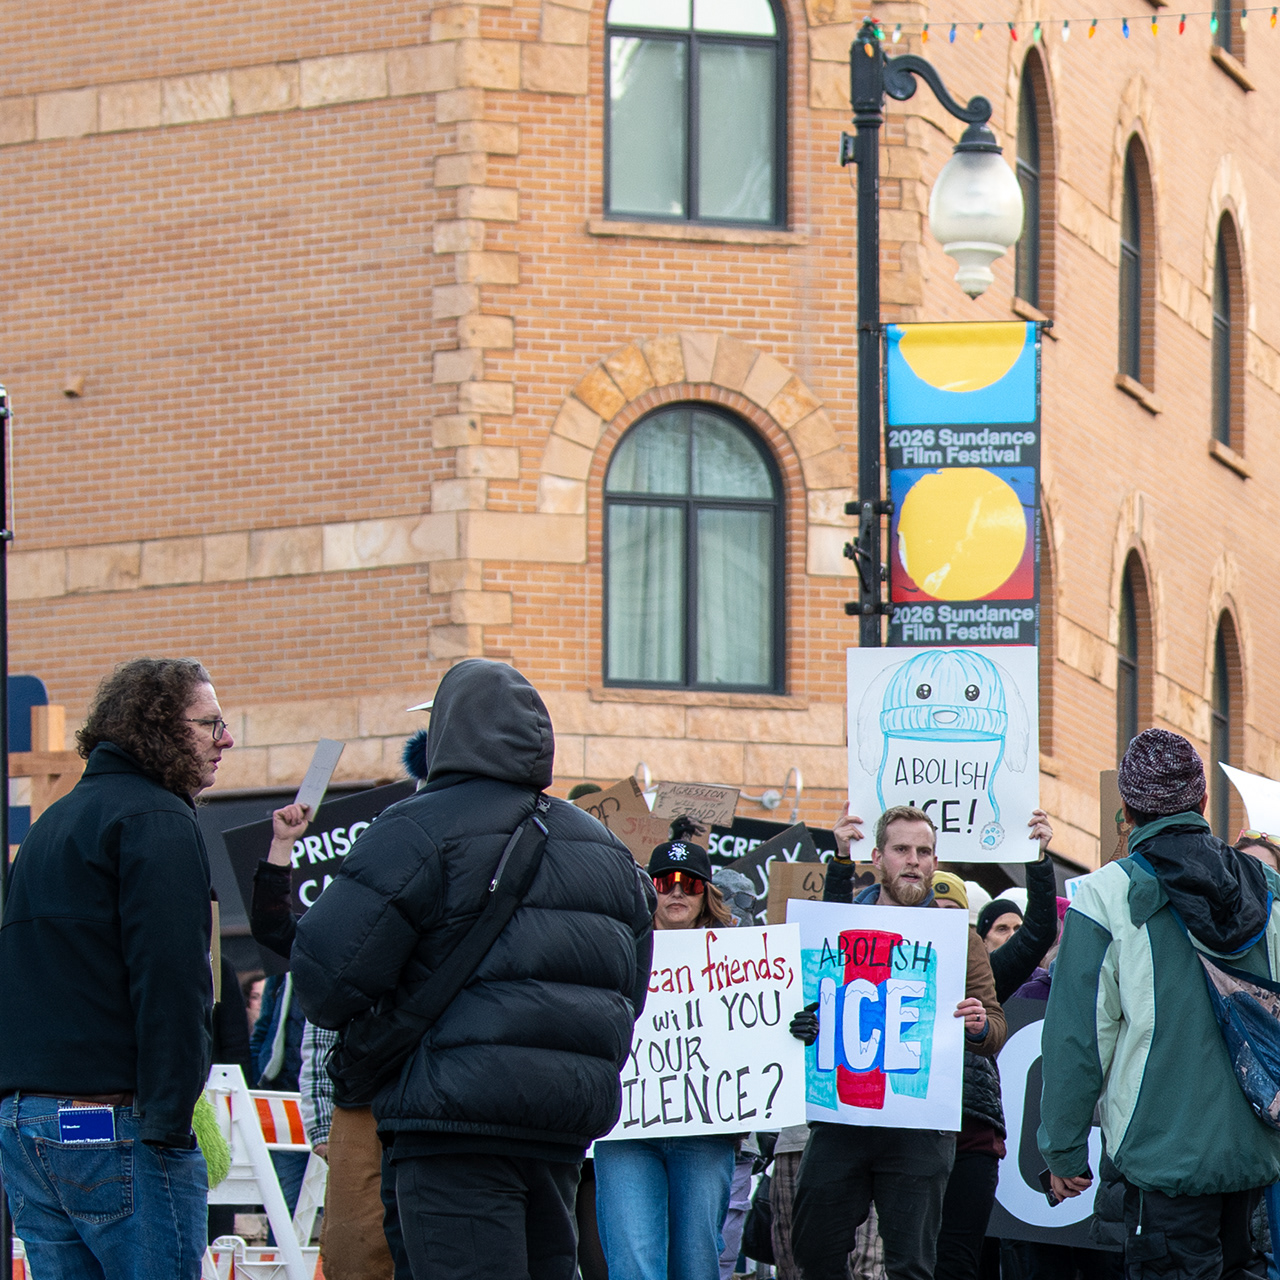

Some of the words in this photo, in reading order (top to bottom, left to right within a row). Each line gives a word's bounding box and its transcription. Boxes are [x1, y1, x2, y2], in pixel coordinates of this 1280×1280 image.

[889, 430, 935, 447] 2026
[938, 428, 1036, 447] Sundance
[902, 447, 943, 464] Film
[946, 445, 1021, 464] Festival
[892, 607, 935, 625] 2026
[938, 604, 1035, 623] Sundance
[902, 623, 943, 642] Film
[945, 622, 1019, 640] Festival
[895, 757, 989, 791] ABOLISH
[290, 817, 377, 869] PRISO
[708, 832, 766, 858] SCRE
[647, 964, 694, 994] can
[701, 930, 794, 994] friends,
[819, 935, 933, 972] ABOLISH
[652, 998, 704, 1032] will
[720, 989, 781, 1031] YOU
[815, 977, 927, 1074] ICE
[630, 1036, 710, 1077] YOUR
[622, 1062, 784, 1129] ILENCE?
